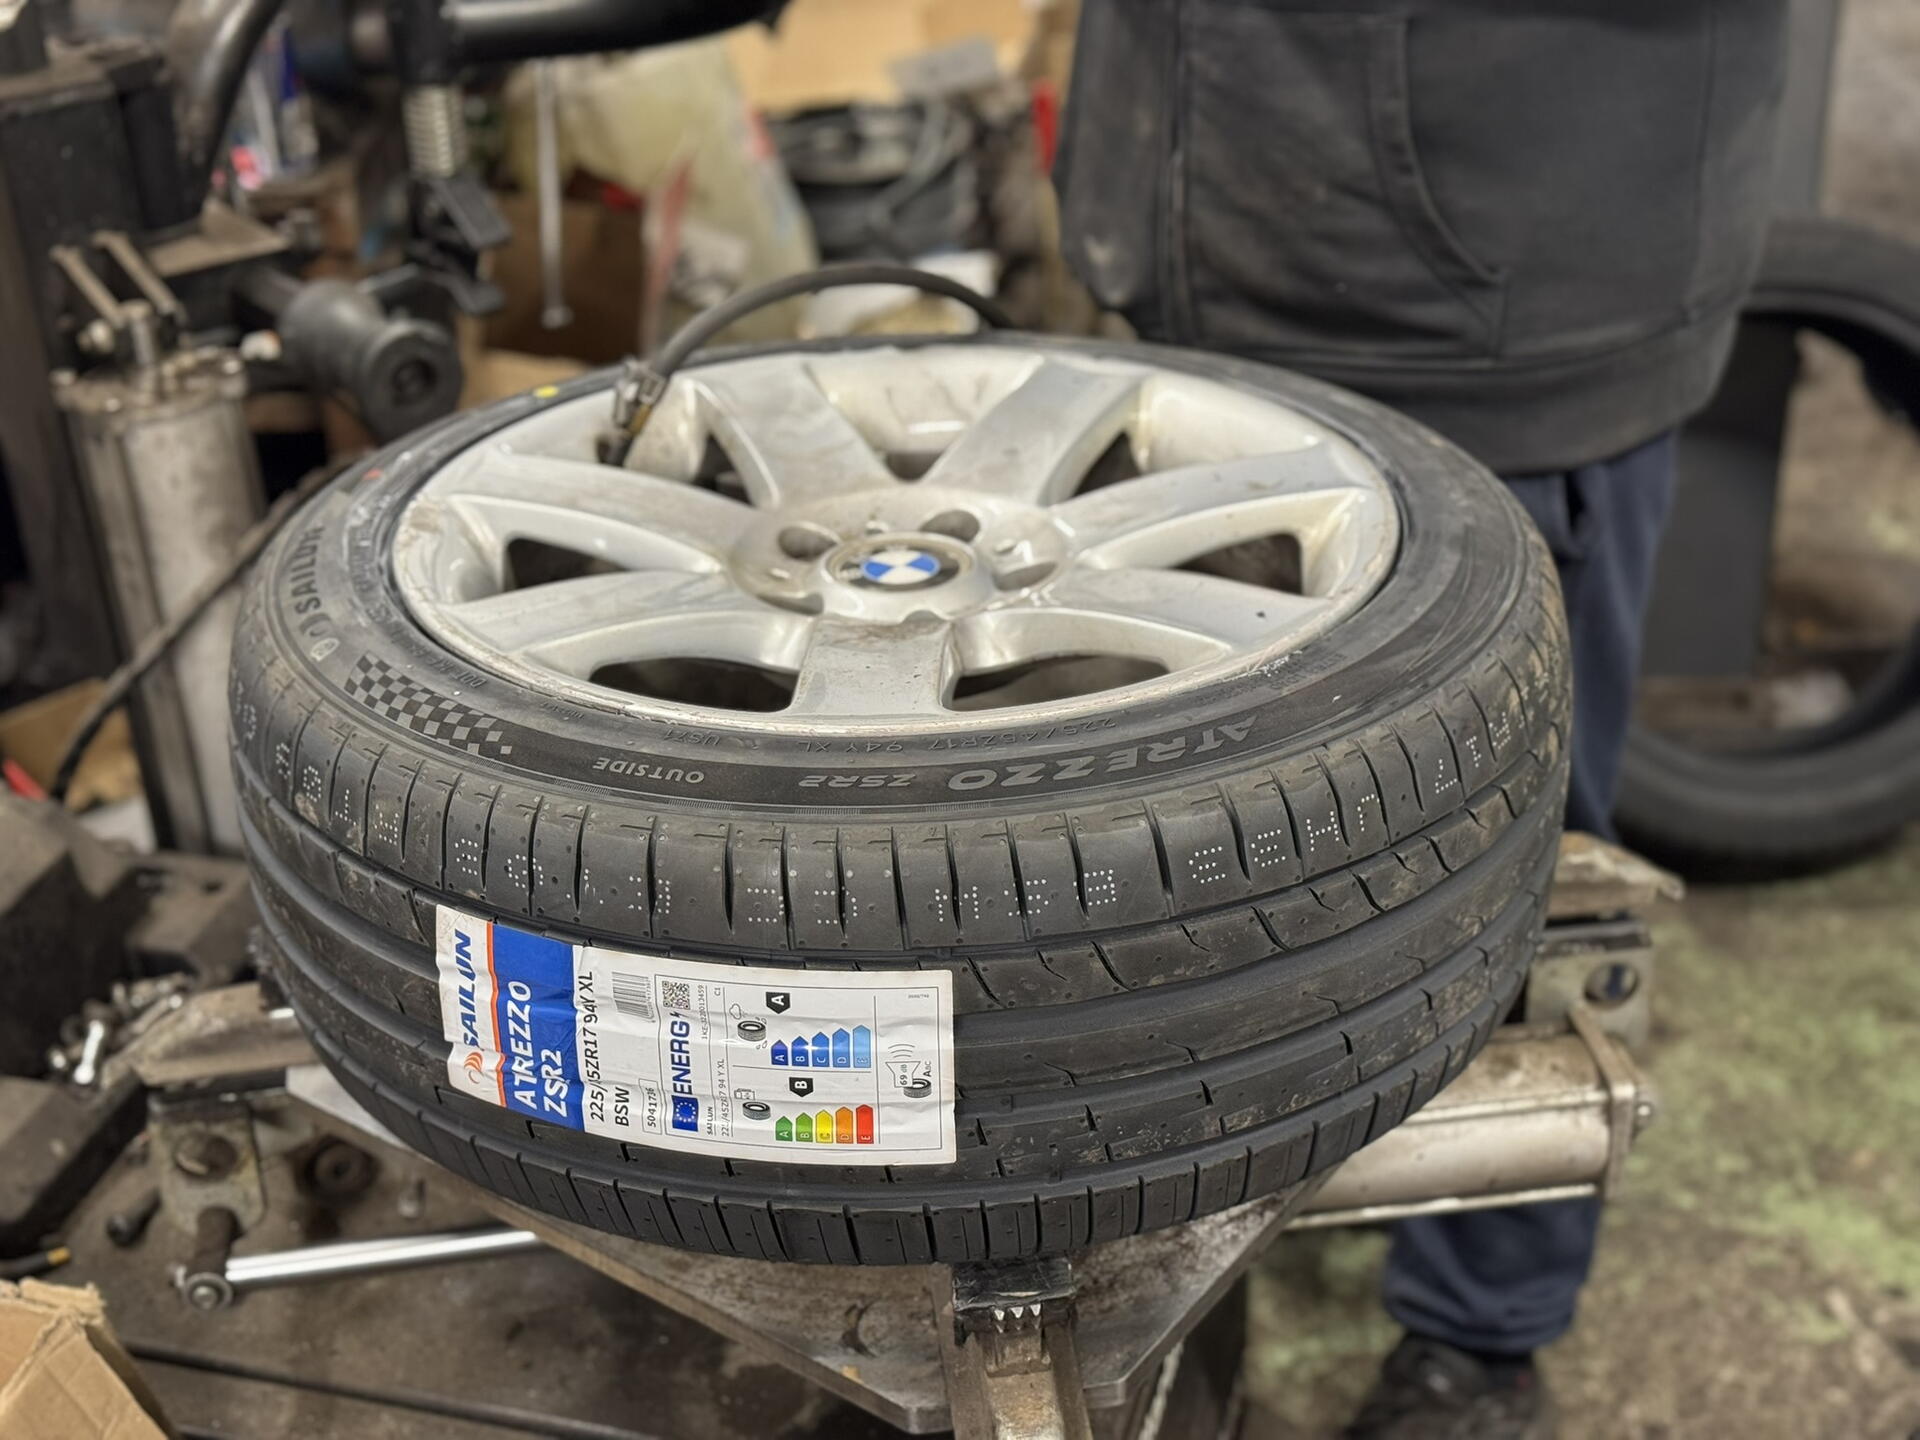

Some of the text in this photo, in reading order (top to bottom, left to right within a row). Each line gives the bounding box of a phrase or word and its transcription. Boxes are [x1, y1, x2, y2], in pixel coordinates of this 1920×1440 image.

[798, 715, 1258, 792] ATREZZO ZSR2
[592, 756, 706, 785] OUTSIDE
[455, 929, 484, 1050] SAILUN
[579, 971, 594, 993] XL
[583, 996, 598, 1025] 94Y
[771, 994, 785, 1006] A
[507, 981, 537, 1110] ATREZZO
[717, 1059, 725, 1069] XL
[541, 1049, 571, 1118] ZSR2
[718, 1079, 727, 1089] 94
[795, 1080, 807, 1090] B
[900, 1074, 908, 1085] 69
[615, 1087, 630, 1127] BSW
